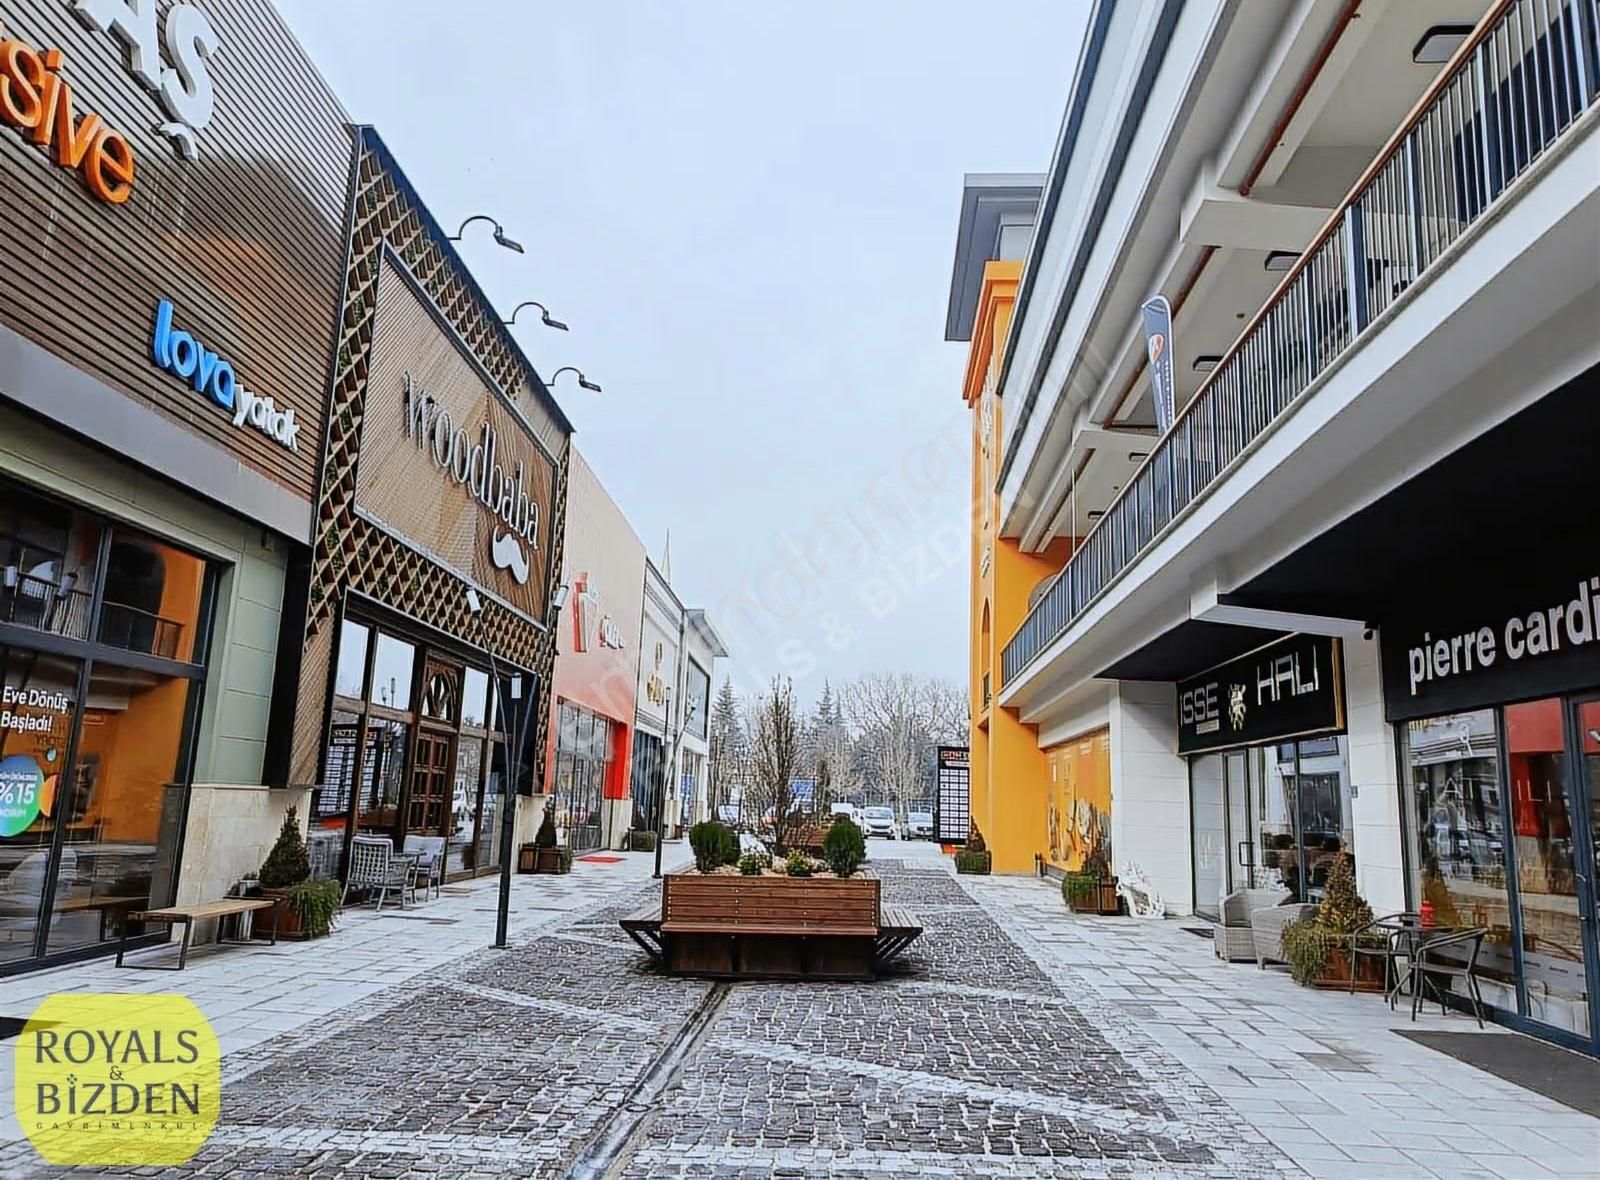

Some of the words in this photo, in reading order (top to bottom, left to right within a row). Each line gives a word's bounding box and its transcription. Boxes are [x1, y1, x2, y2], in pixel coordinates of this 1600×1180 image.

[154, 299, 236, 409] lova
[232, 383, 300, 451] yatak
[1409, 631, 1496, 696] pierre
[0, 710, 53, 734] Başladı!
[2, 685, 27, 705] Eve
[28, 689, 69, 715] Dönüş
